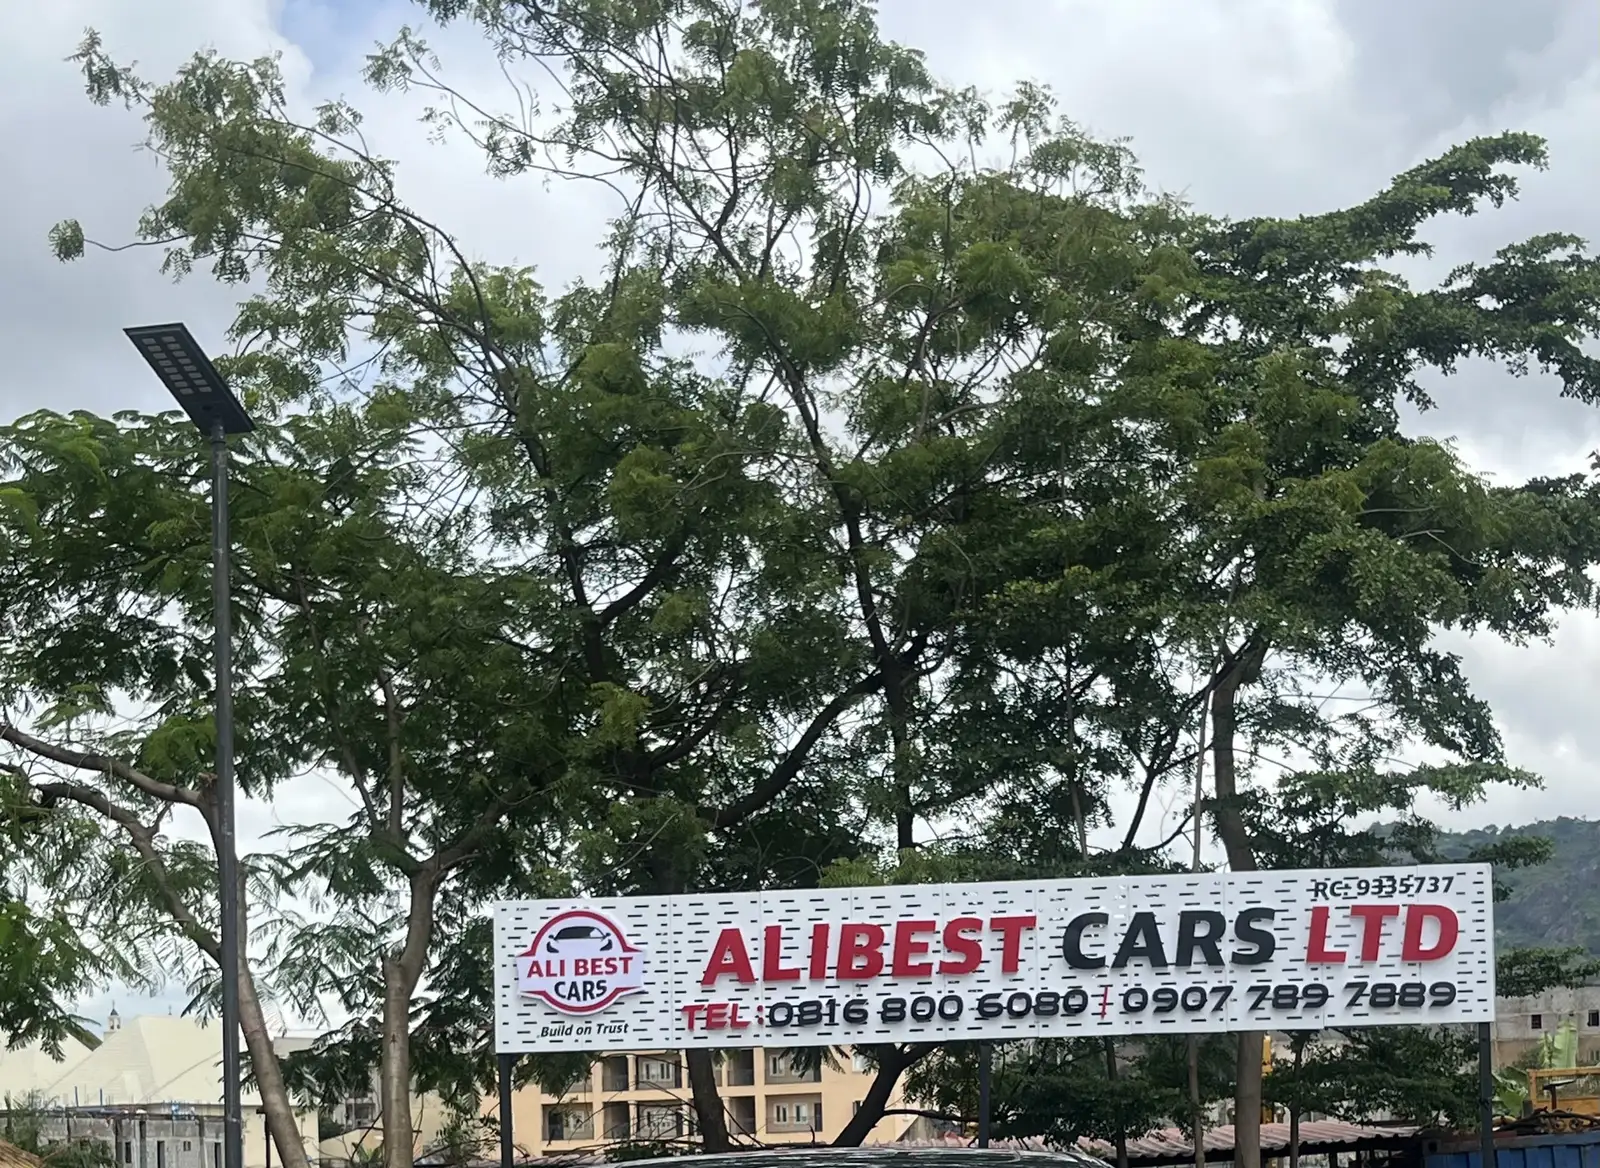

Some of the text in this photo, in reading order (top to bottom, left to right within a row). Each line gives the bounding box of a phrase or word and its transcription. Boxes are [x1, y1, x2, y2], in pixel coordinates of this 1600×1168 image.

[1356, 876, 1454, 896] 9335737
[700, 904, 1459, 985] ALIBEST CARS LTD
[527, 957, 633, 978] ALI BEST
[554, 980, 607, 1001] CARS
[881, 995, 963, 1022] 800
[977, 989, 1089, 1017] 6080
[1122, 986, 1234, 1013] 0907
[1247, 984, 1329, 1010] 789
[1345, 982, 1456, 1008] 7889
[540, 1023, 629, 1038] Build on Trust
